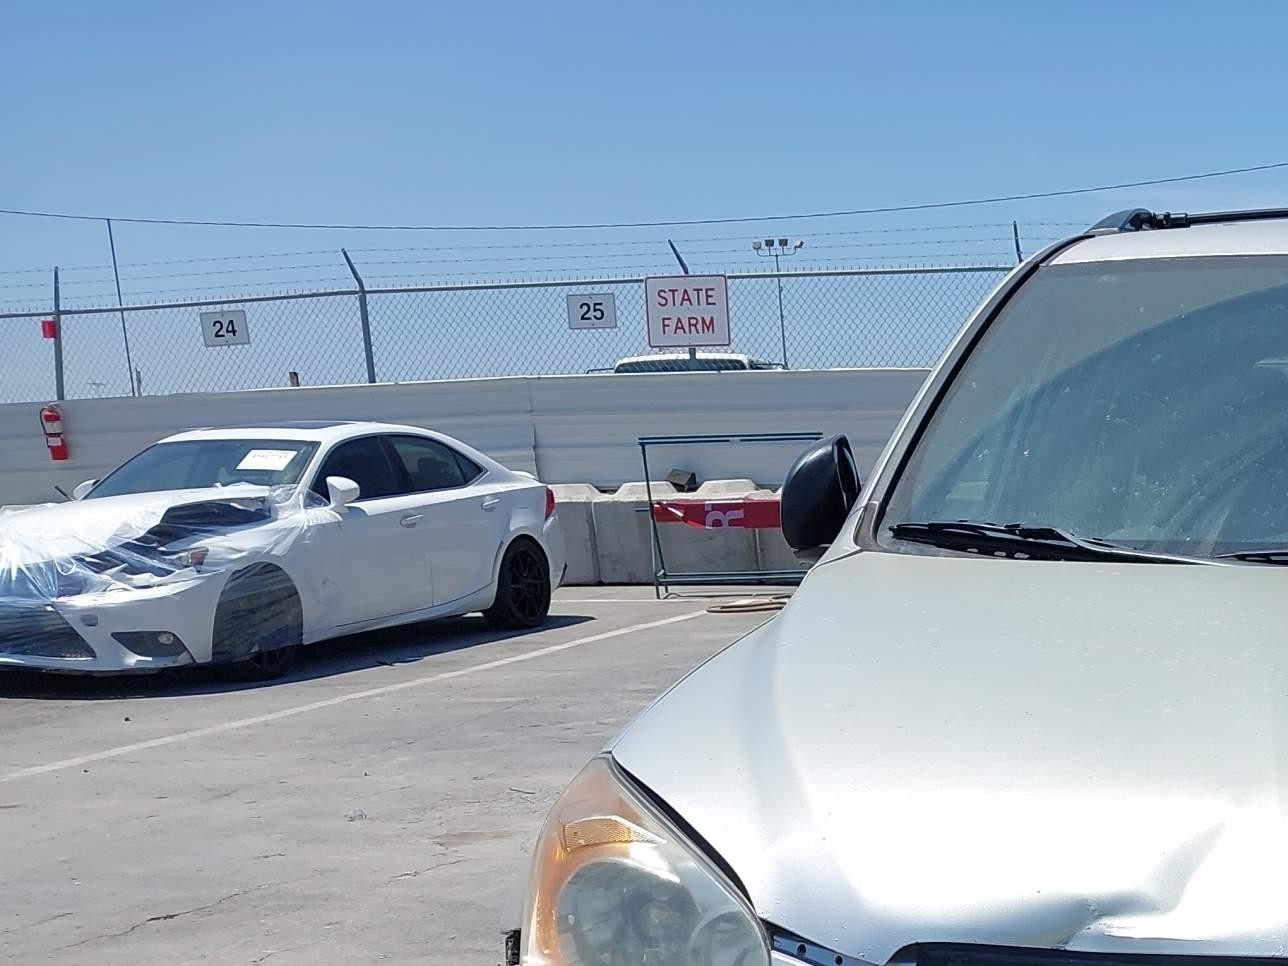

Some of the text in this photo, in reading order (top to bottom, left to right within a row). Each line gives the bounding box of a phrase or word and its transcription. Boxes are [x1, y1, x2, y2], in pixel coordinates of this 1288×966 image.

[657, 288, 717, 307] STATE
[579, 302, 605, 321] 25
[212, 319, 238, 338] 24
[661, 316, 715, 335] FARM
